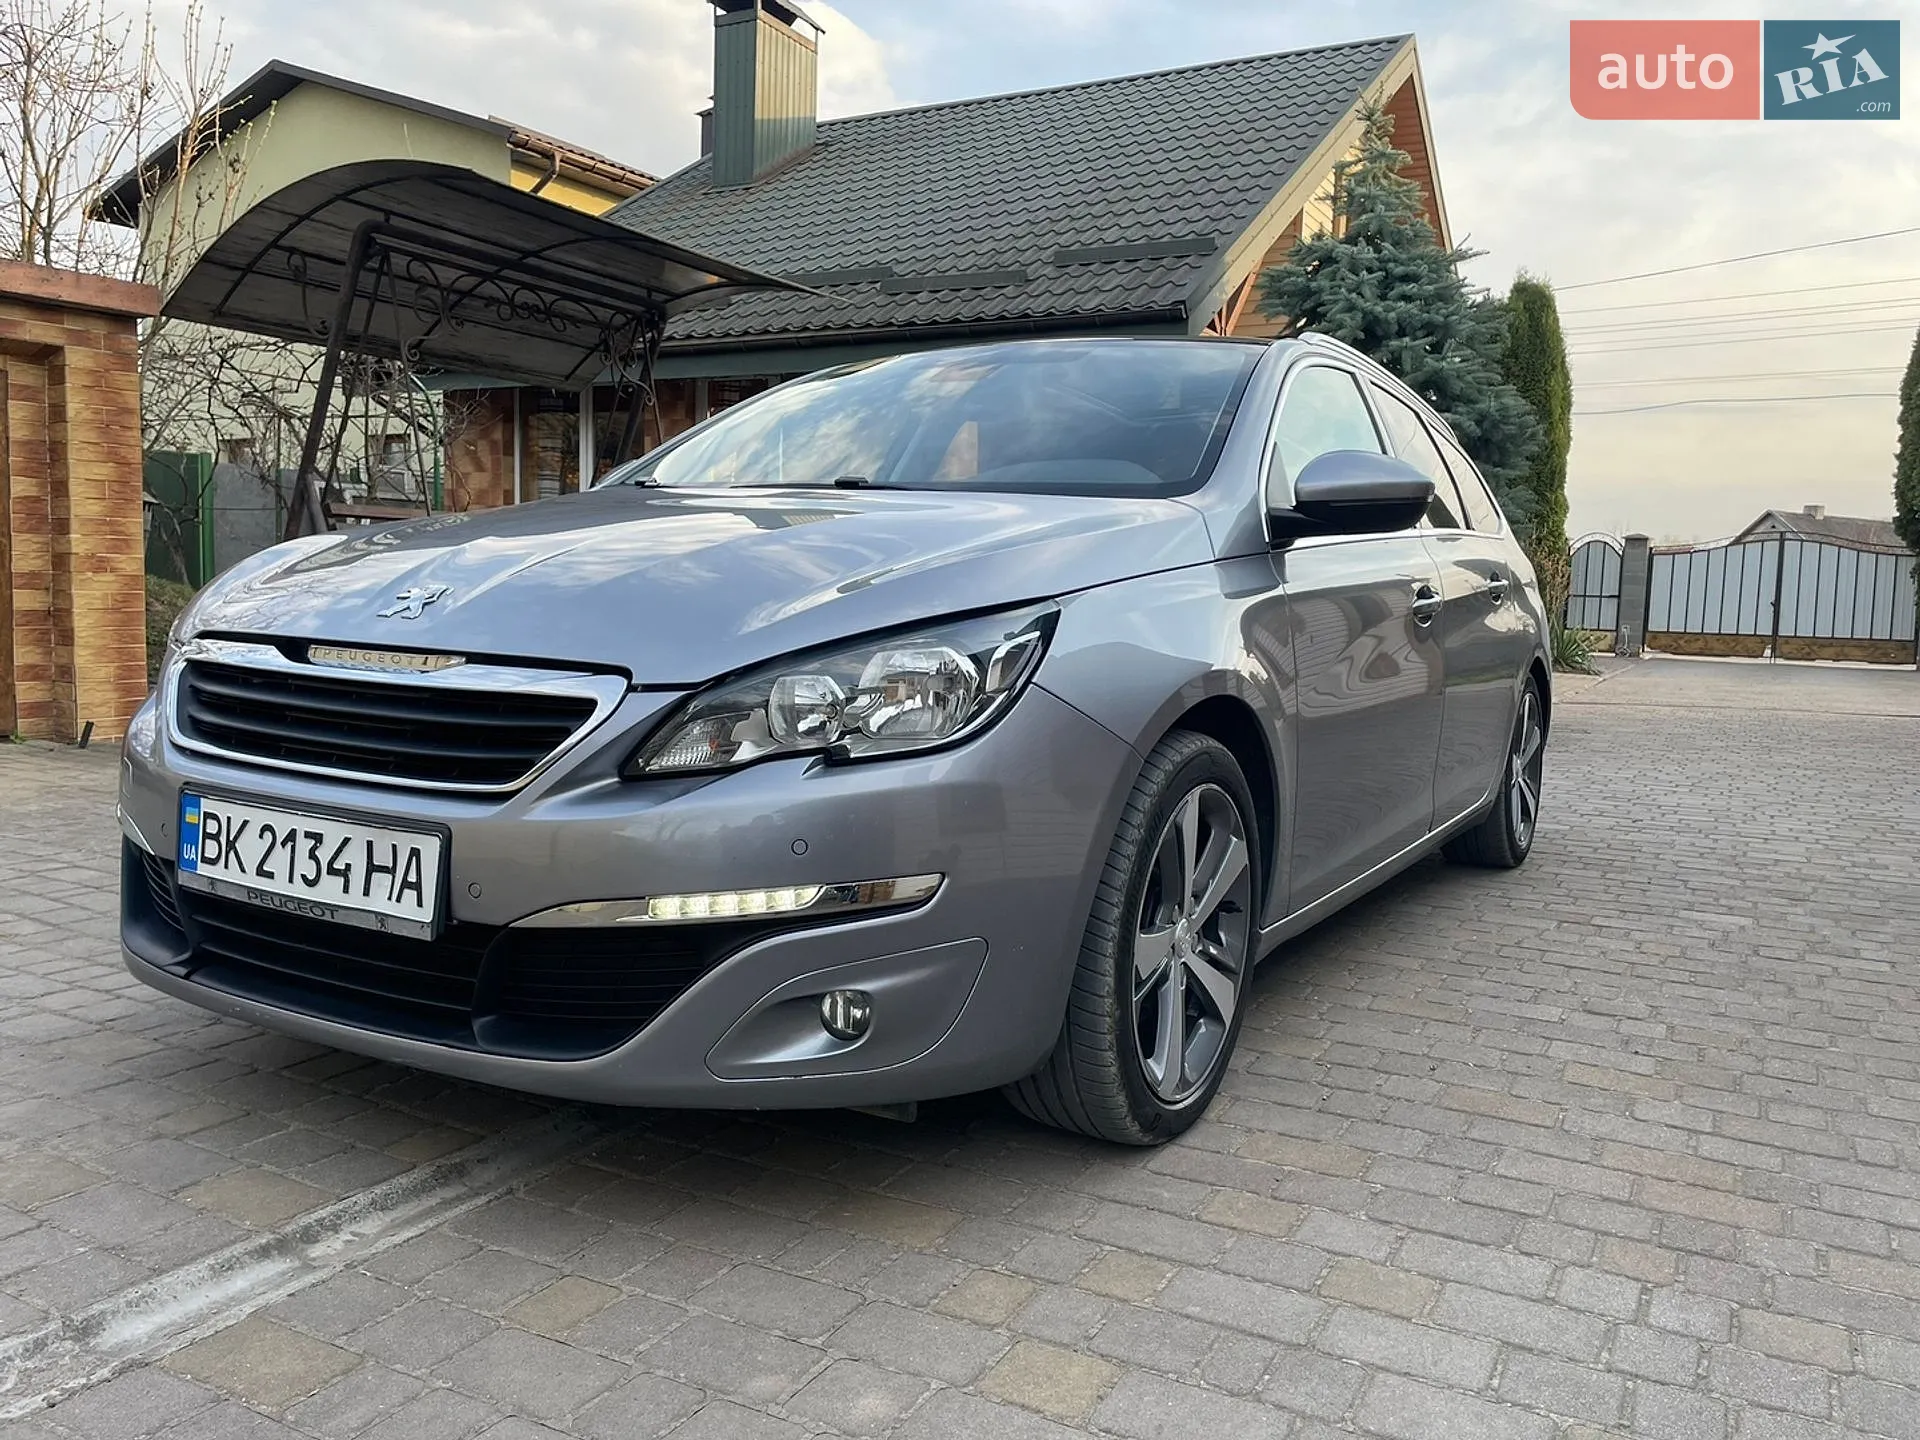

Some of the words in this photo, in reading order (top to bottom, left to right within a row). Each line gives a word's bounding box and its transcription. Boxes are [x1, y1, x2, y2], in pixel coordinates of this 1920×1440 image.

[324, 649, 415, 667] PEUGEOT
[183, 843, 197, 861] UA
[200, 811, 250, 873] BK
[255, 823, 352, 894] 2134
[362, 839, 424, 908] HA
[246, 891, 339, 919] PEUGEOT
